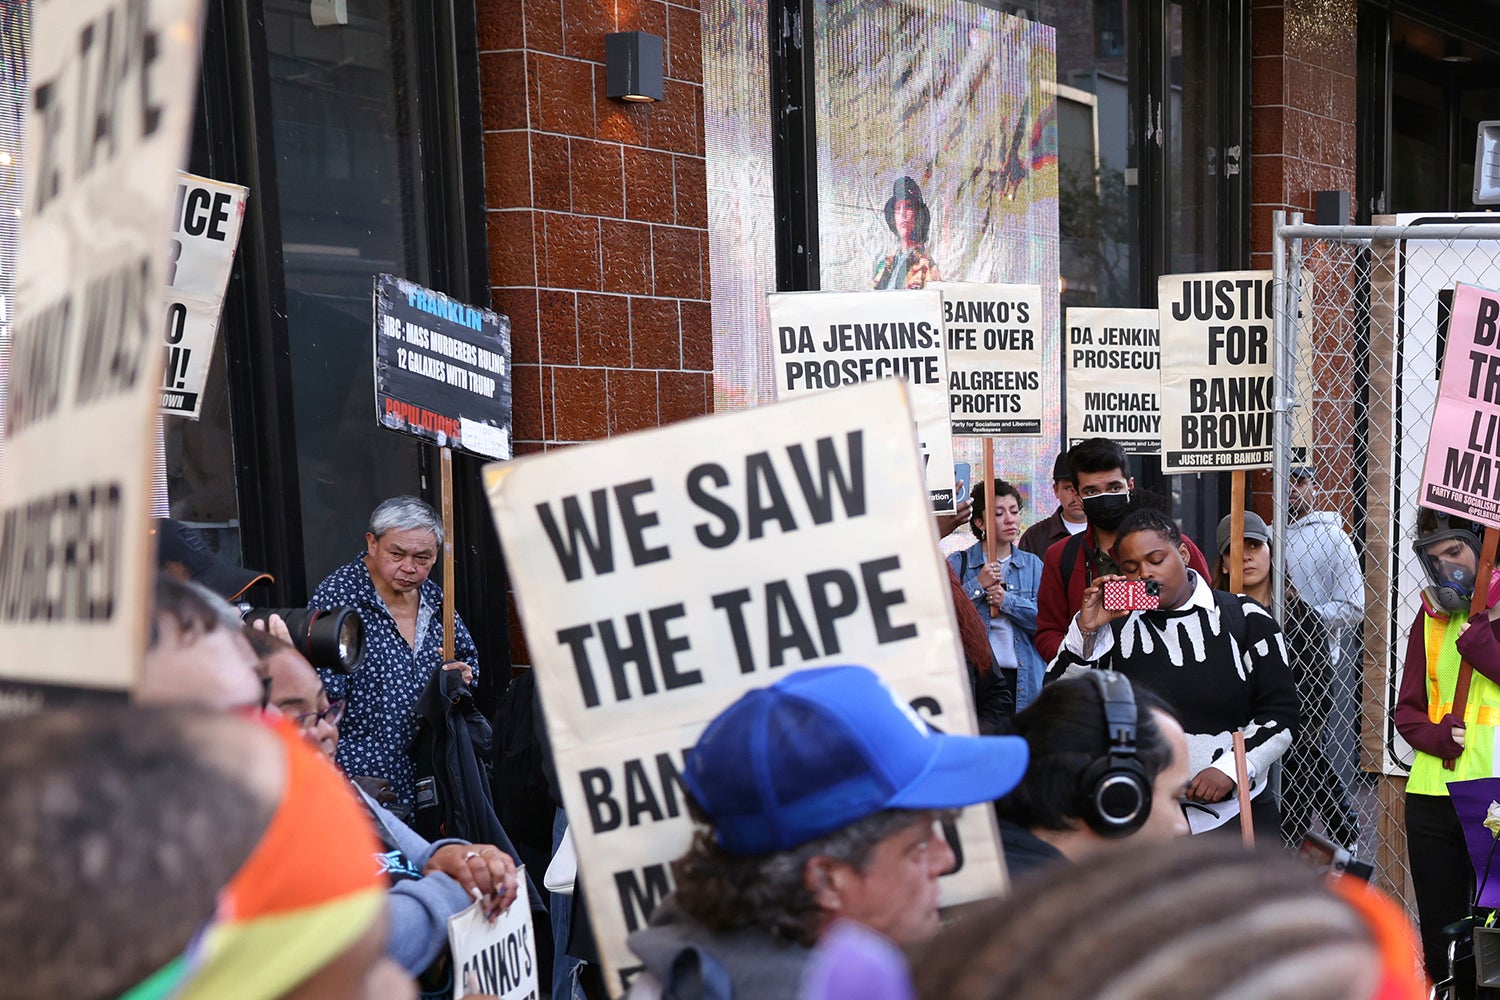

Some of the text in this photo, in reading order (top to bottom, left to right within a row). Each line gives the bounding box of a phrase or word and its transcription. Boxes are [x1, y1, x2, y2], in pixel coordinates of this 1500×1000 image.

[408, 288, 483, 332] FRANKLIN
[1172, 279, 1303, 321] JUSTIC
[406, 322, 430, 349] MASS
[431, 330, 477, 367] MURDERERS
[478, 348, 505, 375] RULING
[779, 321, 941, 354] DA JENKINS:
[948, 328, 1034, 351] IFE OVER
[1071, 327, 1160, 346] DA JENKIN
[1209, 325, 1267, 366] FOR
[397, 348, 495, 398] 12 GALAXIES WITH TRUMP
[786, 355, 939, 390] PROSECUTE
[1073, 350, 1160, 370] PROSECUT
[949, 371, 1040, 390] ALGREENS
[385, 398, 460, 439] POPULATIONS
[951, 393, 1022, 413] PROFITS
[1085, 393, 1159, 411] MICHAEL
[1083, 415, 1160, 433] ANTHONY
[1178, 453, 1213, 466] JUSTICE
[1215, 452, 1232, 465] FOR
[1233, 451, 1262, 465] BANKO
[537, 477, 671, 583] WE
[686, 430, 867, 549] SAW
[1431, 486, 1450, 500] PARTY
[1450, 491, 1463, 503] FOR
[1463, 494, 1497, 511] SOCIALISM
[557, 555, 918, 709] THE TAPE
[579, 745, 693, 834] BAN
